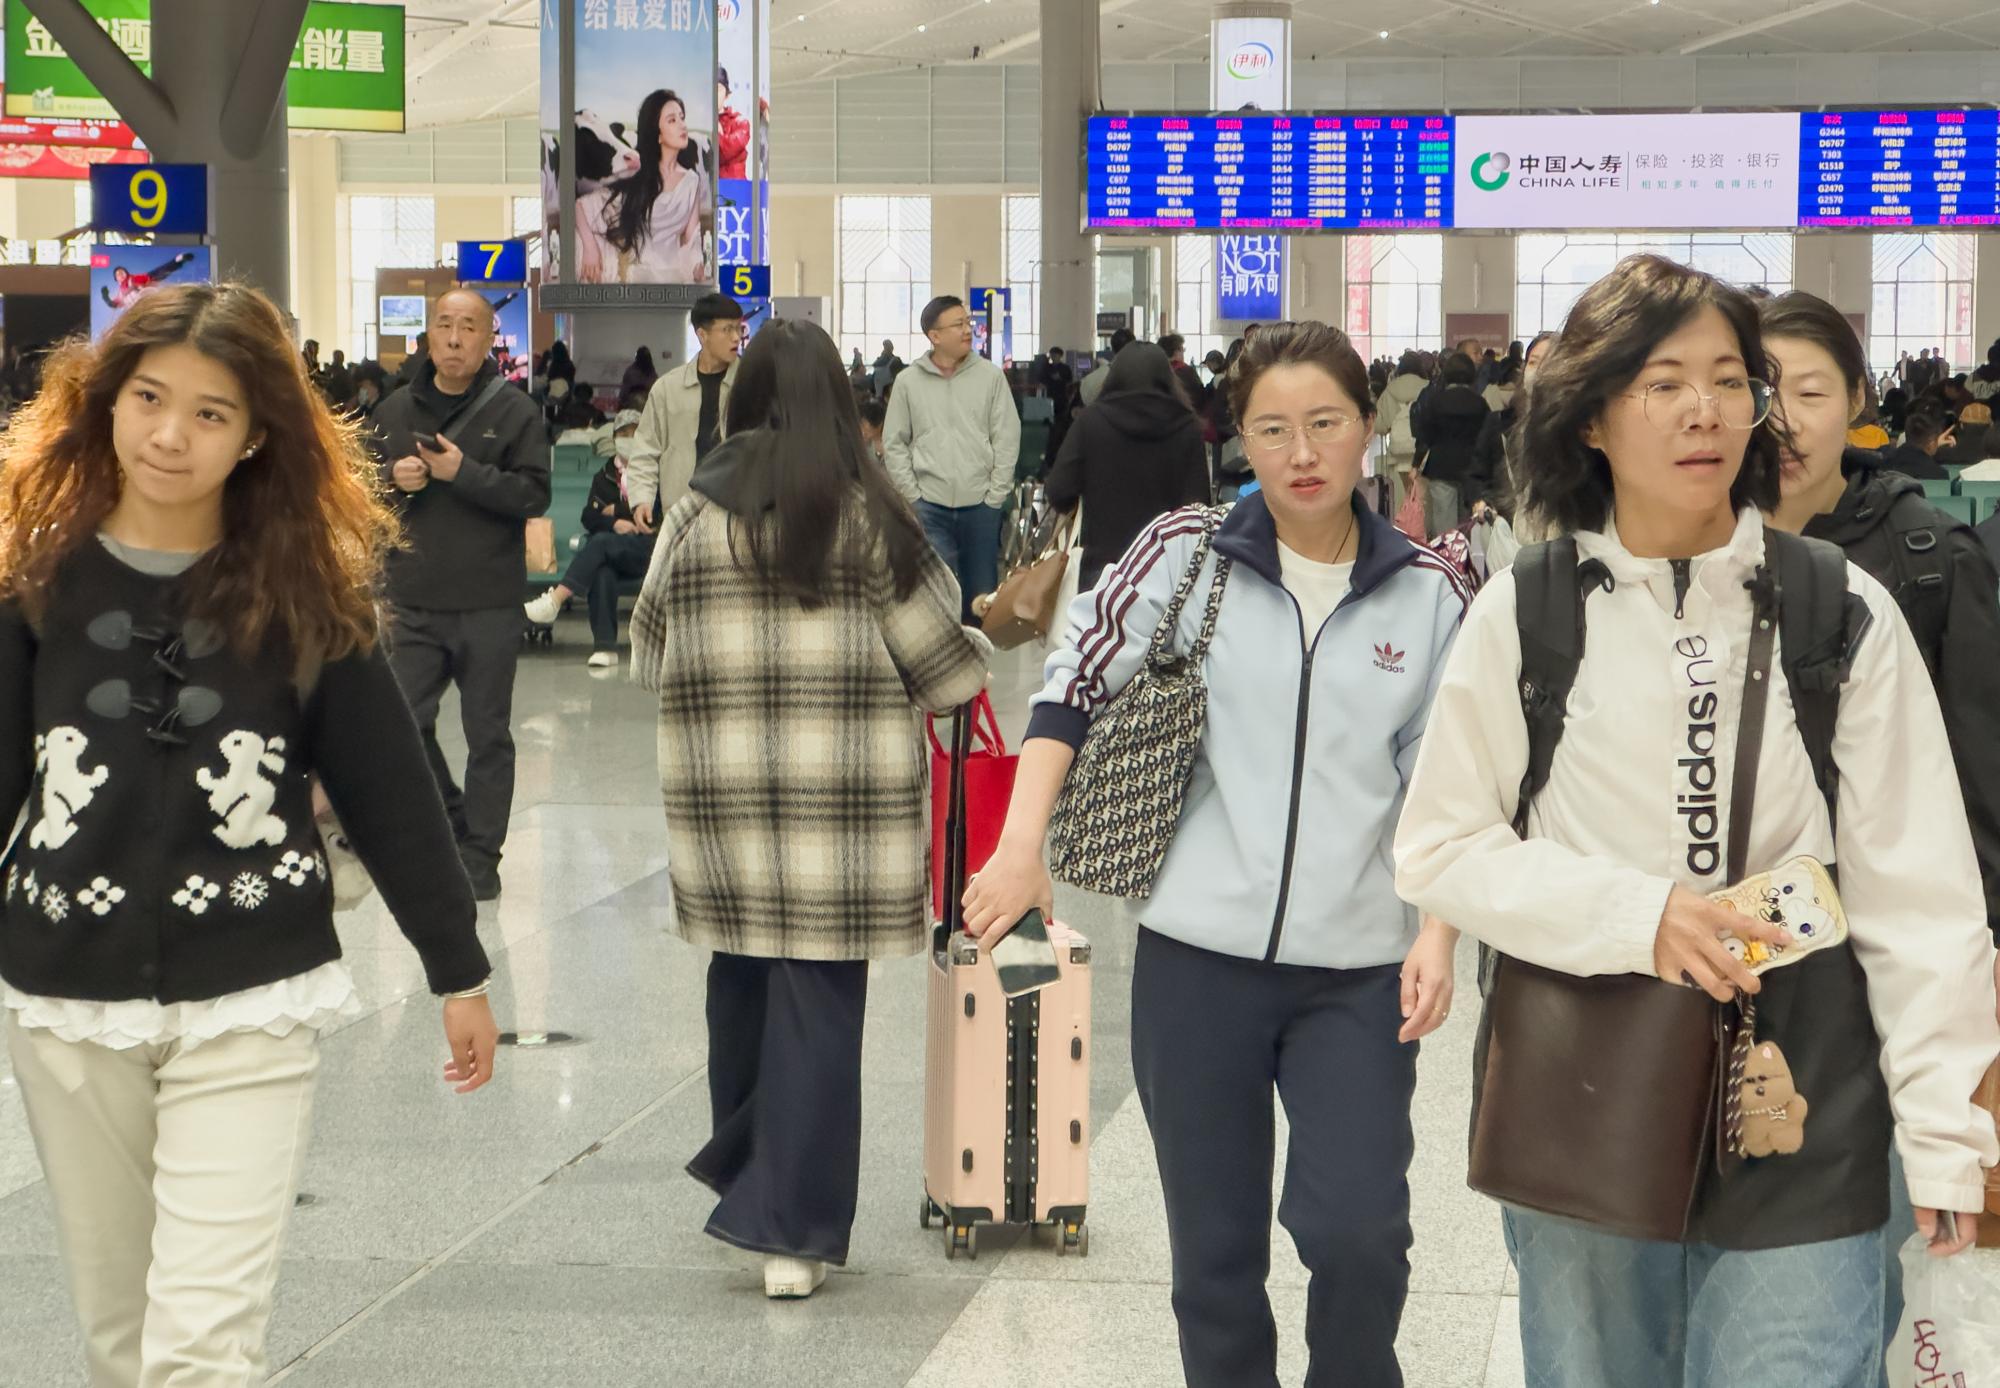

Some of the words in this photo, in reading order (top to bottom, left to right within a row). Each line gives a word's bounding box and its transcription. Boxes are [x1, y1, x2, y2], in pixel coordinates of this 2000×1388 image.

[584, 0, 710, 32] 给最爱的人
[25, 16, 151, 61] 金酒
[289, 27, 385, 73] 能量
[1232, 53, 1267, 68] 伊利
[1820, 128, 1846, 137] G2464
[1819, 139, 1846, 148] D6767
[1635, 154, 1669, 169] 保险
[1822, 151, 1842, 159] T303
[1519, 154, 1622, 174] 中国人寿
[1519, 177, 1575, 188] CHINA
[1583, 177, 1620, 188] LIFE
[1821, 173, 1842, 182] C657
[1818, 184, 1844, 193] G2470
[129, 169, 168, 228] 9
[1818, 196, 1844, 205] G2570
[1819, 207, 1841, 216] D318
[1220, 234, 1278, 251] WHY
[479, 243, 504, 279] 7
[1221, 251, 1280, 275] NOT
[733, 267, 753, 295] 5
[1220, 273, 1279, 297] 有何不可
[1372, 659, 1406, 674] adidas
